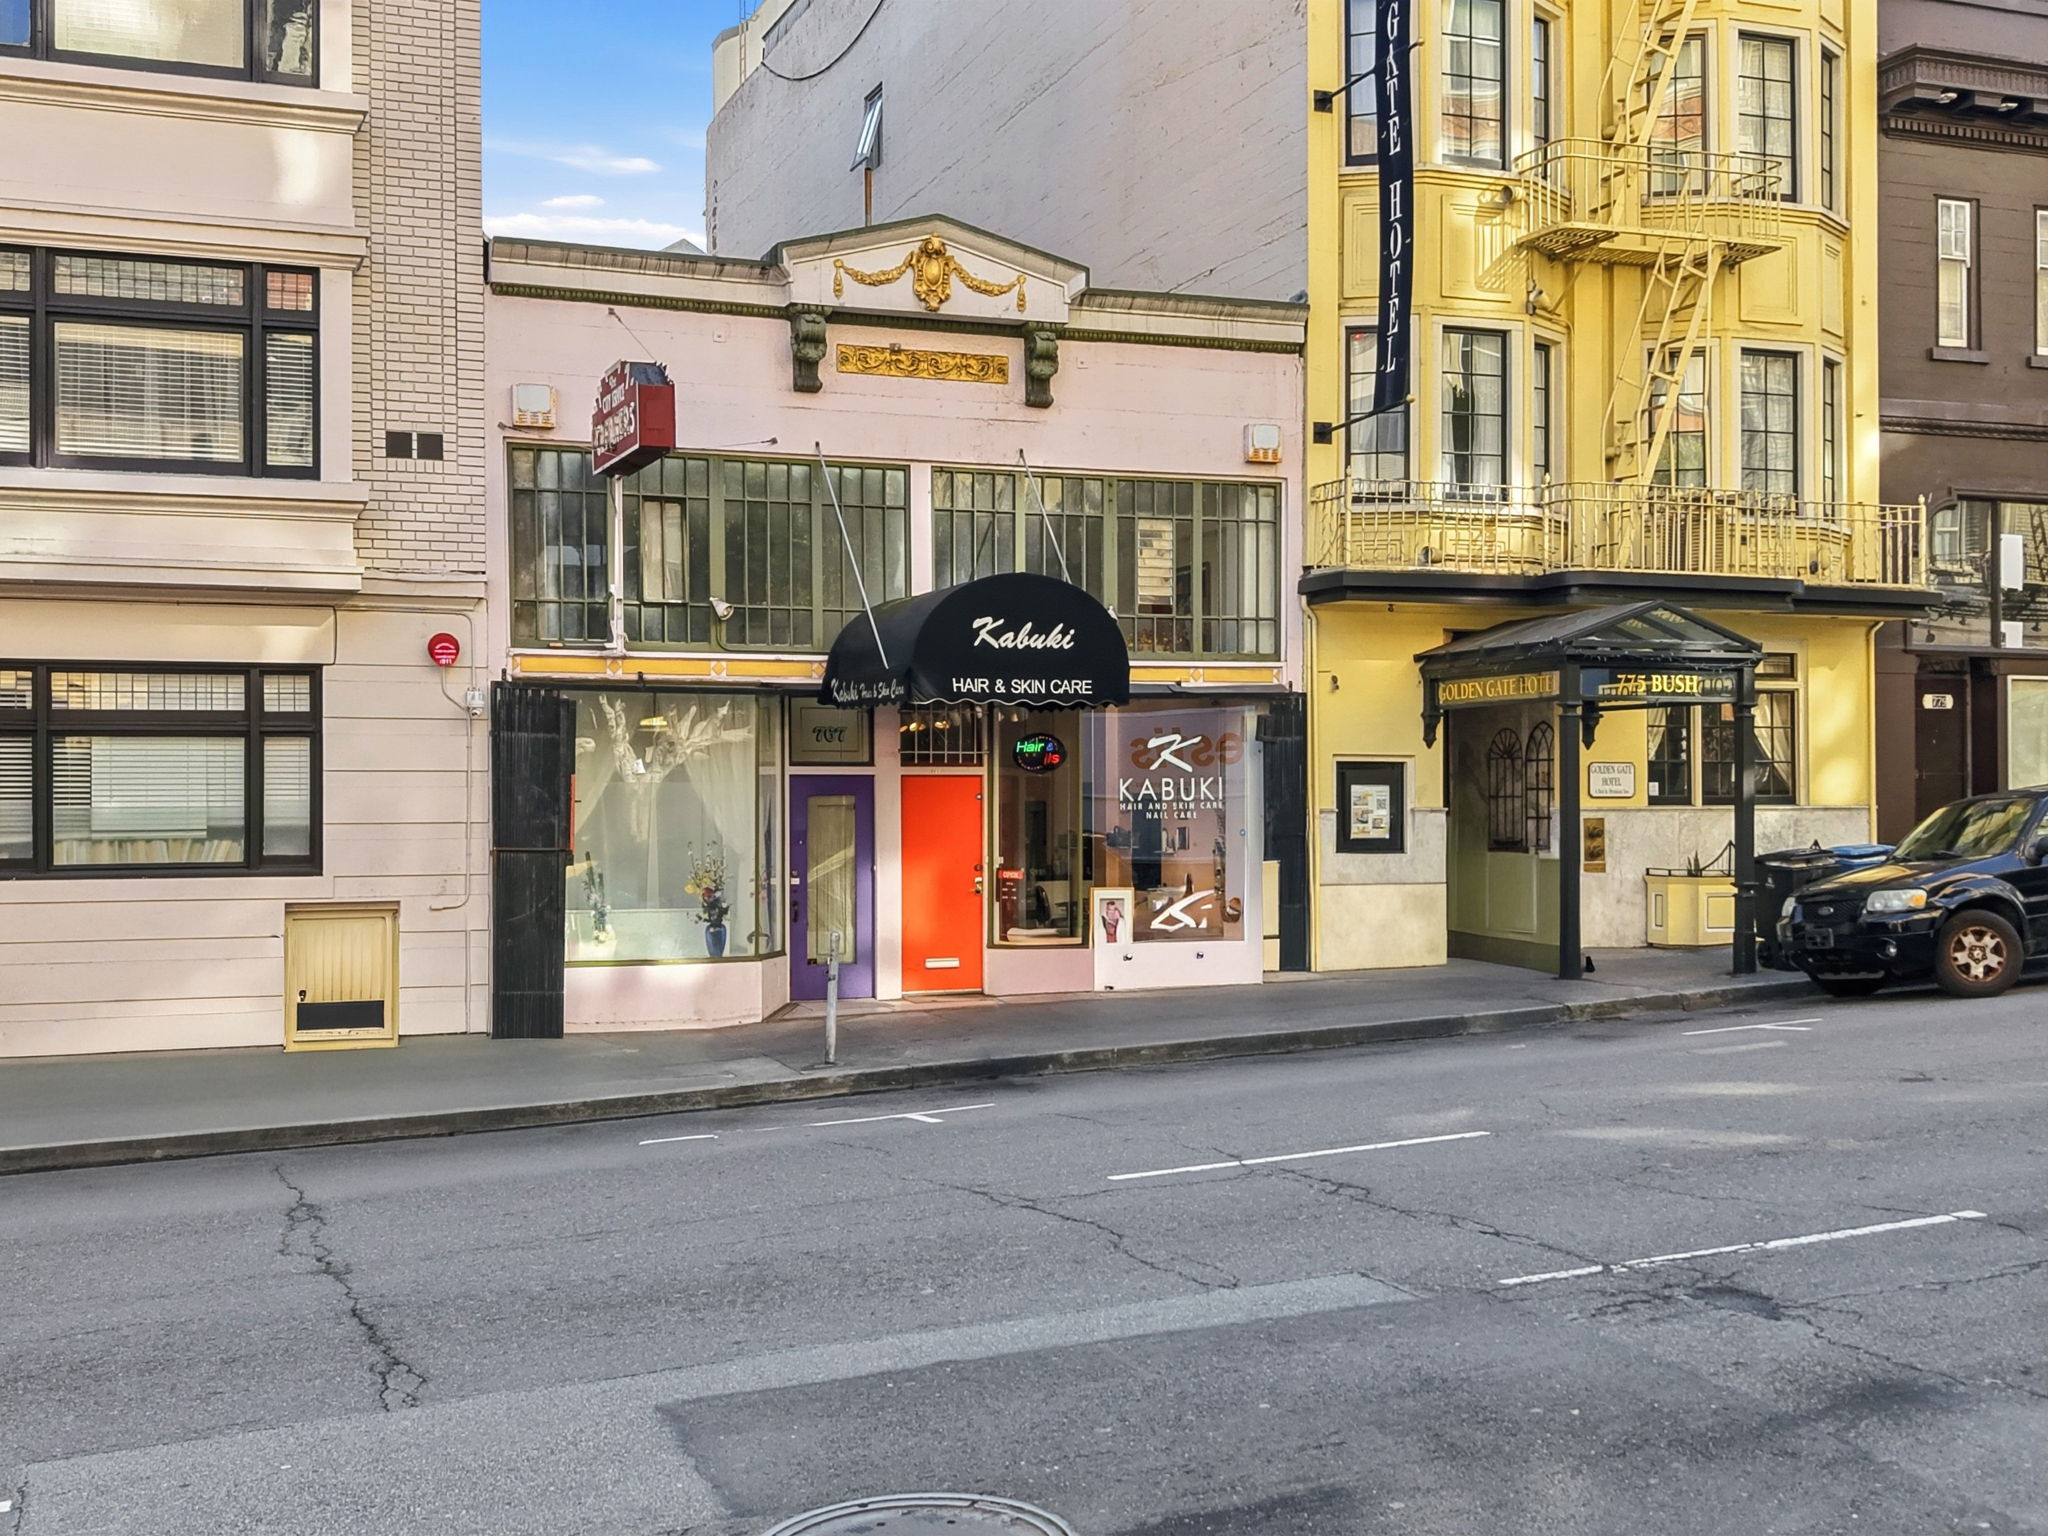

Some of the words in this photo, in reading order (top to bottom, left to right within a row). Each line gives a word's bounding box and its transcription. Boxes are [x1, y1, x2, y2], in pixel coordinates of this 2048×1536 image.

[1386, 1, 1400, 156] GATE
[1385, 179, 1402, 374] HOTEL
[972, 616, 1075, 649] Kabuki
[831, 678, 859, 702] Kabuki
[952, 678, 990, 693] HAIR
[994, 678, 1006, 693] &
[1011, 679, 1046, 694] SKIN
[1050, 679, 1093, 694] CARE
[1438, 682, 1484, 701] GOLDEN
[1486, 677, 1517, 697] GATE
[1616, 674, 1647, 693] 775
[1650, 674, 1701, 693] BUSH
[1016, 738, 1045, 753] Hair
[1119, 777, 1223, 802] KABUKI
[1120, 802, 1143, 811] HAIR
[1148, 802, 1168, 811] AND
[1173, 802, 1195, 810] SKIN
[1200, 801, 1223, 809] CARE
[1146, 811, 1168, 819] NAIL
[1174, 811, 1197, 819] CARE
